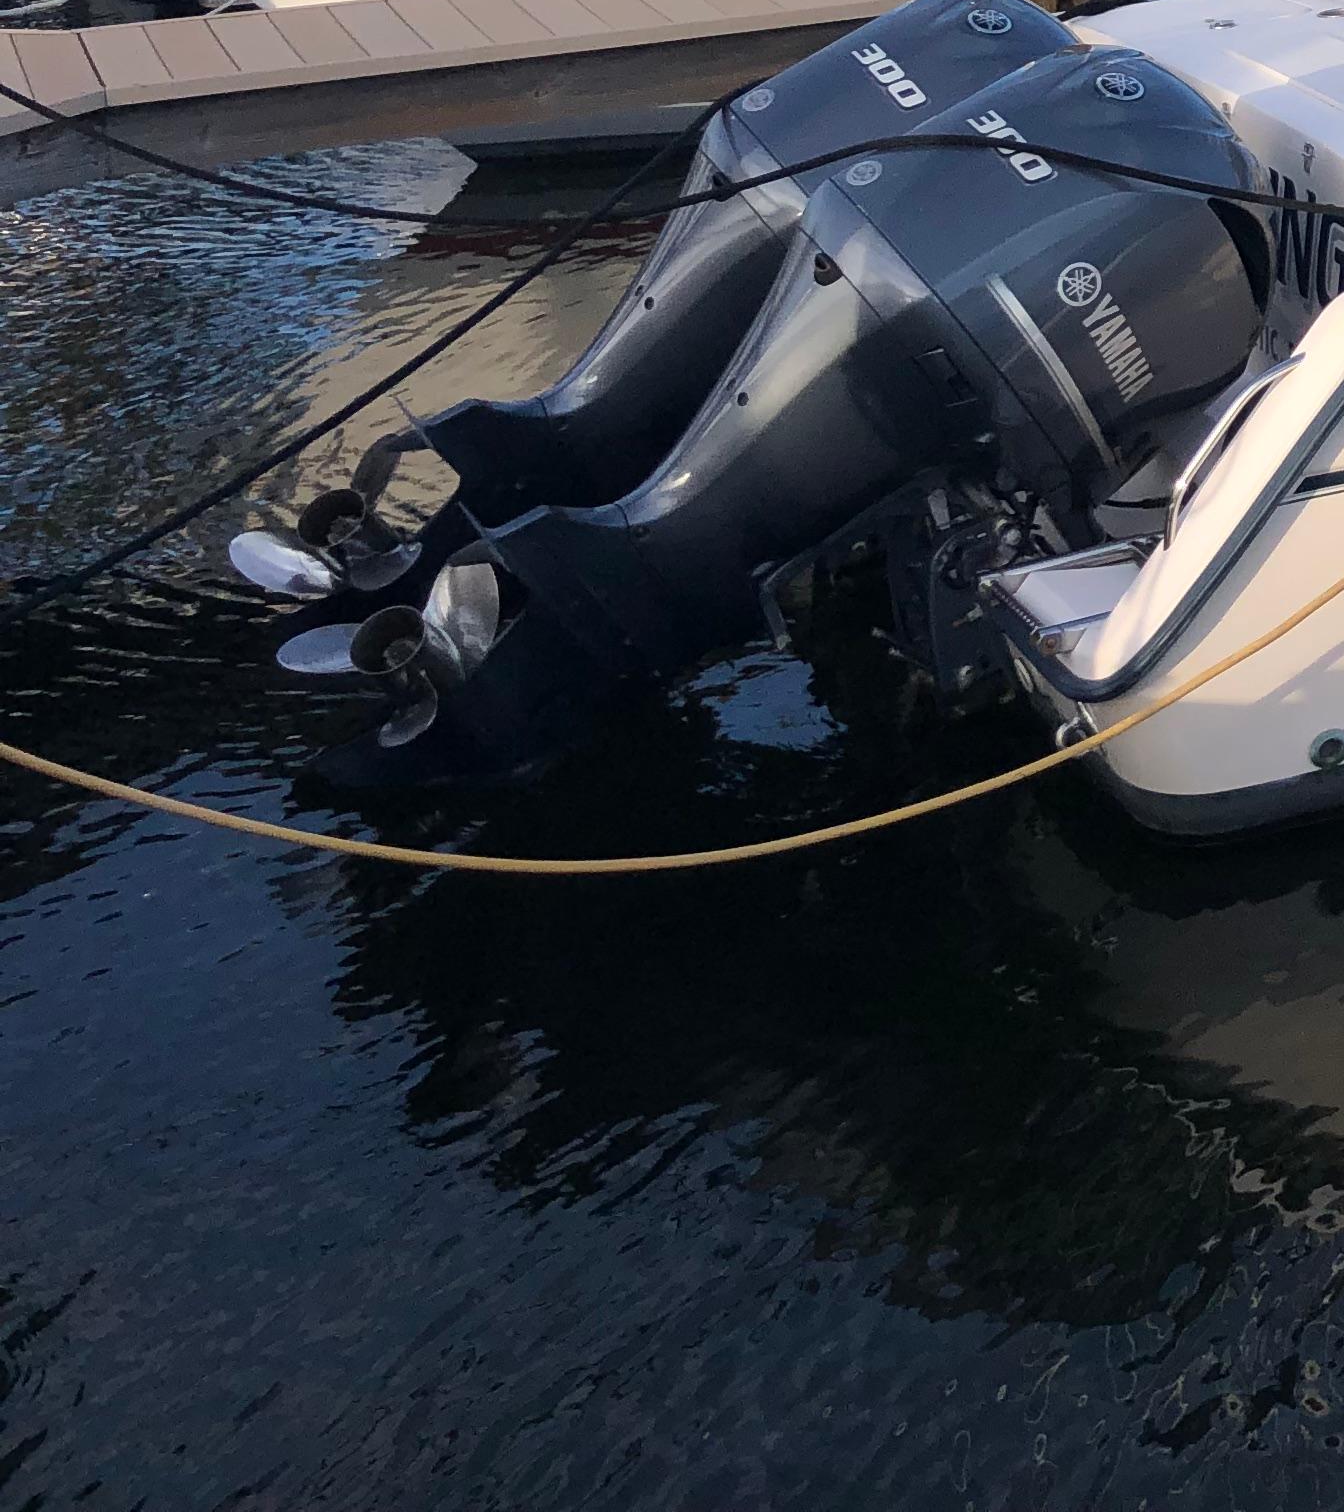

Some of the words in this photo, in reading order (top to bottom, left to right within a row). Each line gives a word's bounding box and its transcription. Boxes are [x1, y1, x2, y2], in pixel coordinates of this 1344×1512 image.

[851, 43, 928, 110] 300
[966, 110, 1055, 183] 300
[1082, 292, 1154, 404] YAMAHA
